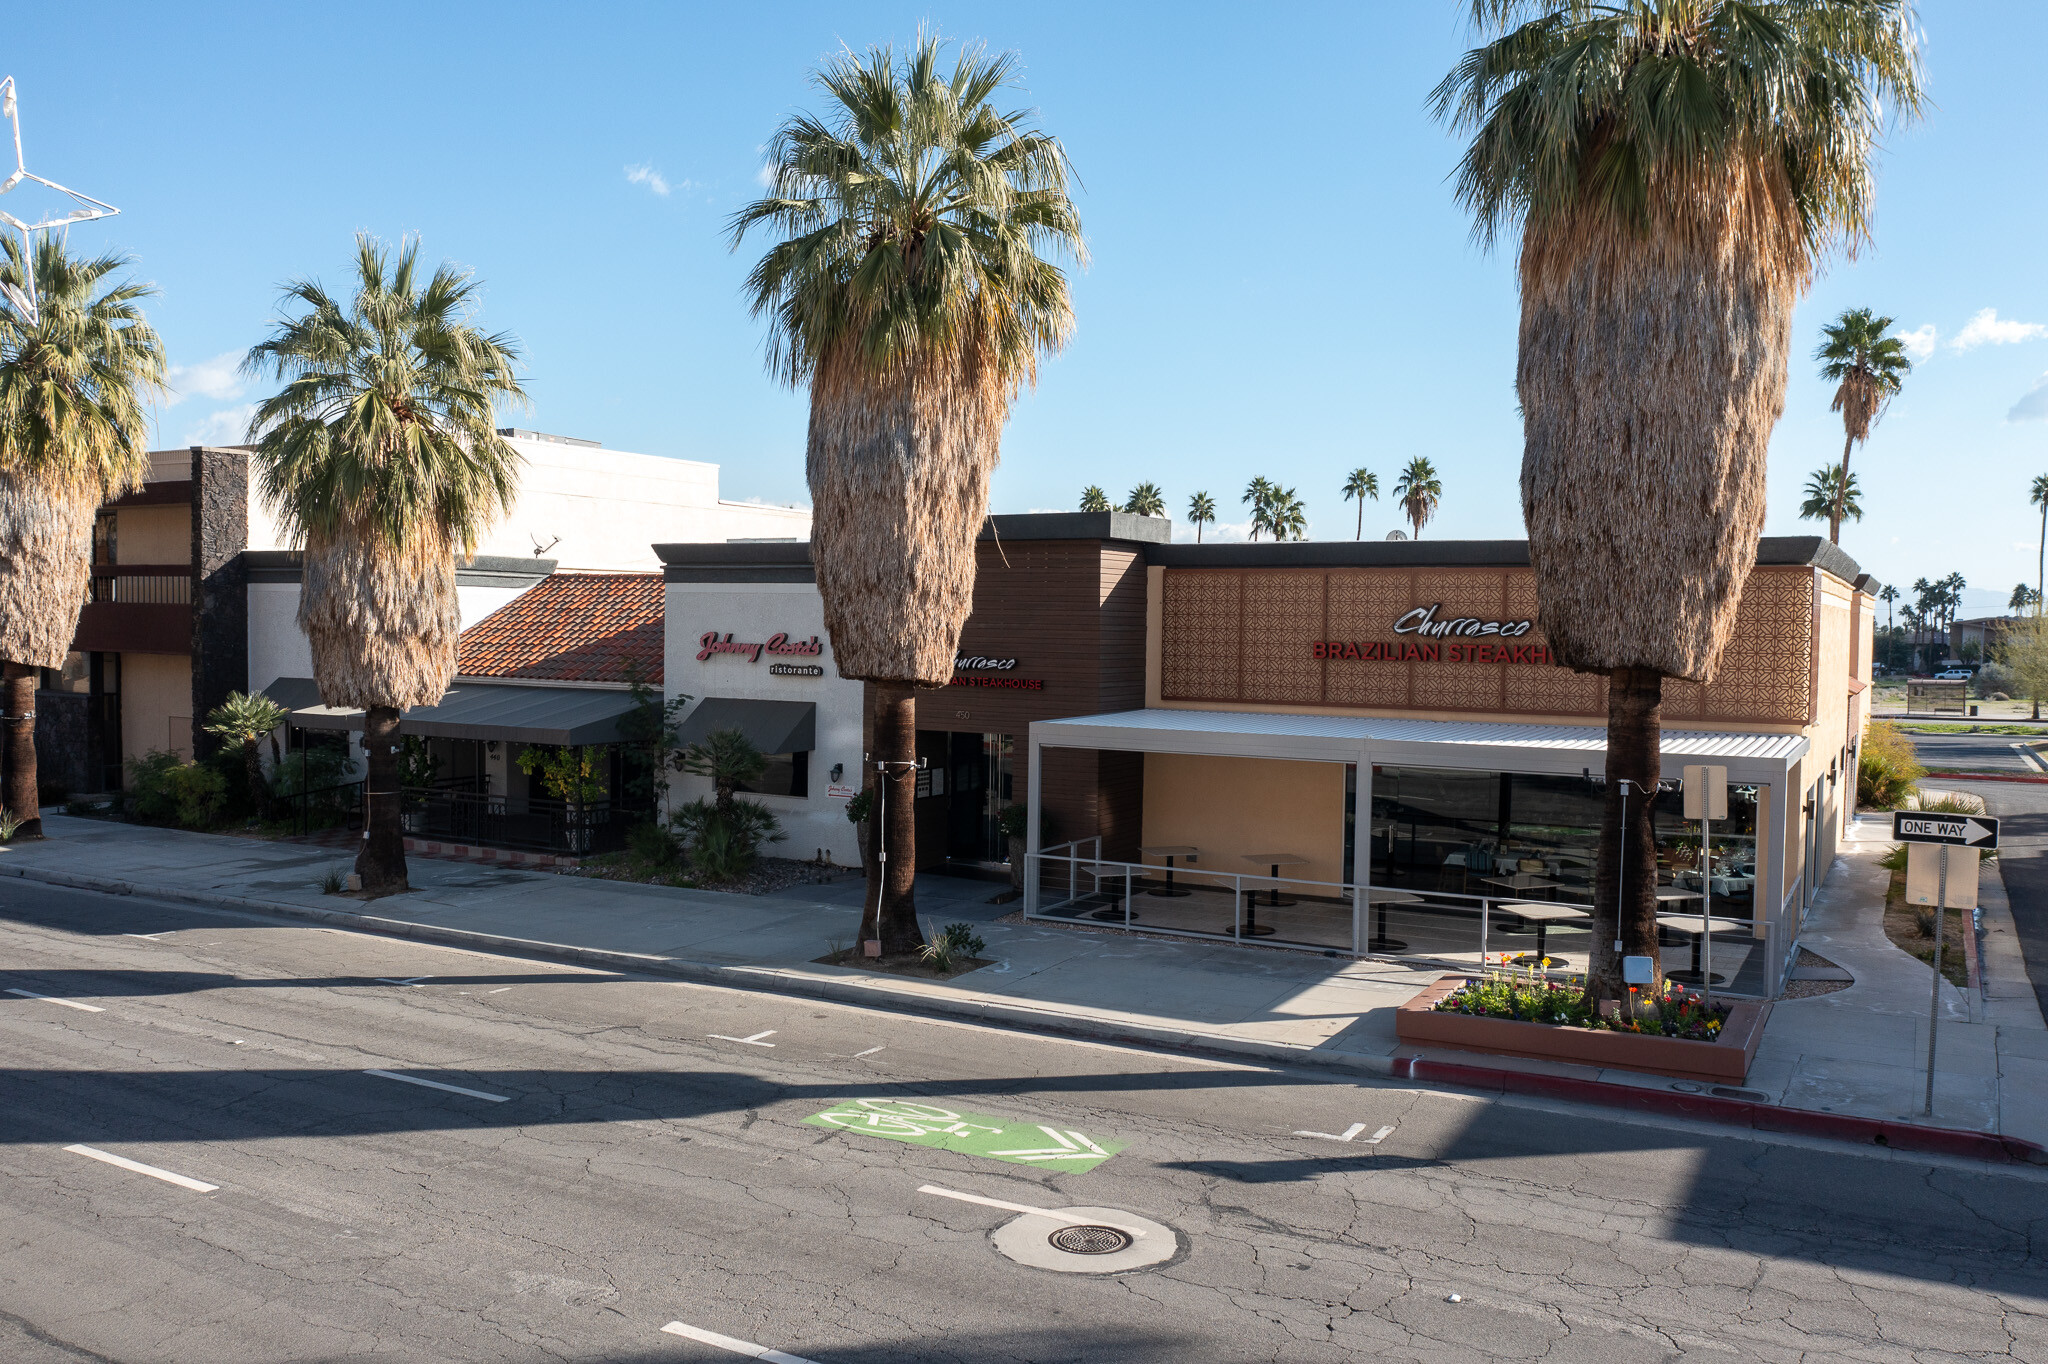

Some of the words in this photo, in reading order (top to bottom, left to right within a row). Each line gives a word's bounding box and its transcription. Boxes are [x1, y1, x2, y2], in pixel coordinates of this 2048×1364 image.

[1394, 604, 1530, 638] Churrasco
[696, 631, 763, 663] Johnny
[764, 632, 823, 655] Costa's
[1312, 642, 1440, 661] BRAZILIAN
[1448, 643, 1554, 664] STEAKH
[953, 650, 1016, 670] urrasco
[770, 665, 819, 675] ristorante
[969, 677, 1041, 690] STEAKHOUSE
[955, 710, 970, 720] 450
[1904, 821, 1932, 833] ONE
[1938, 823, 1966, 836] WAY
